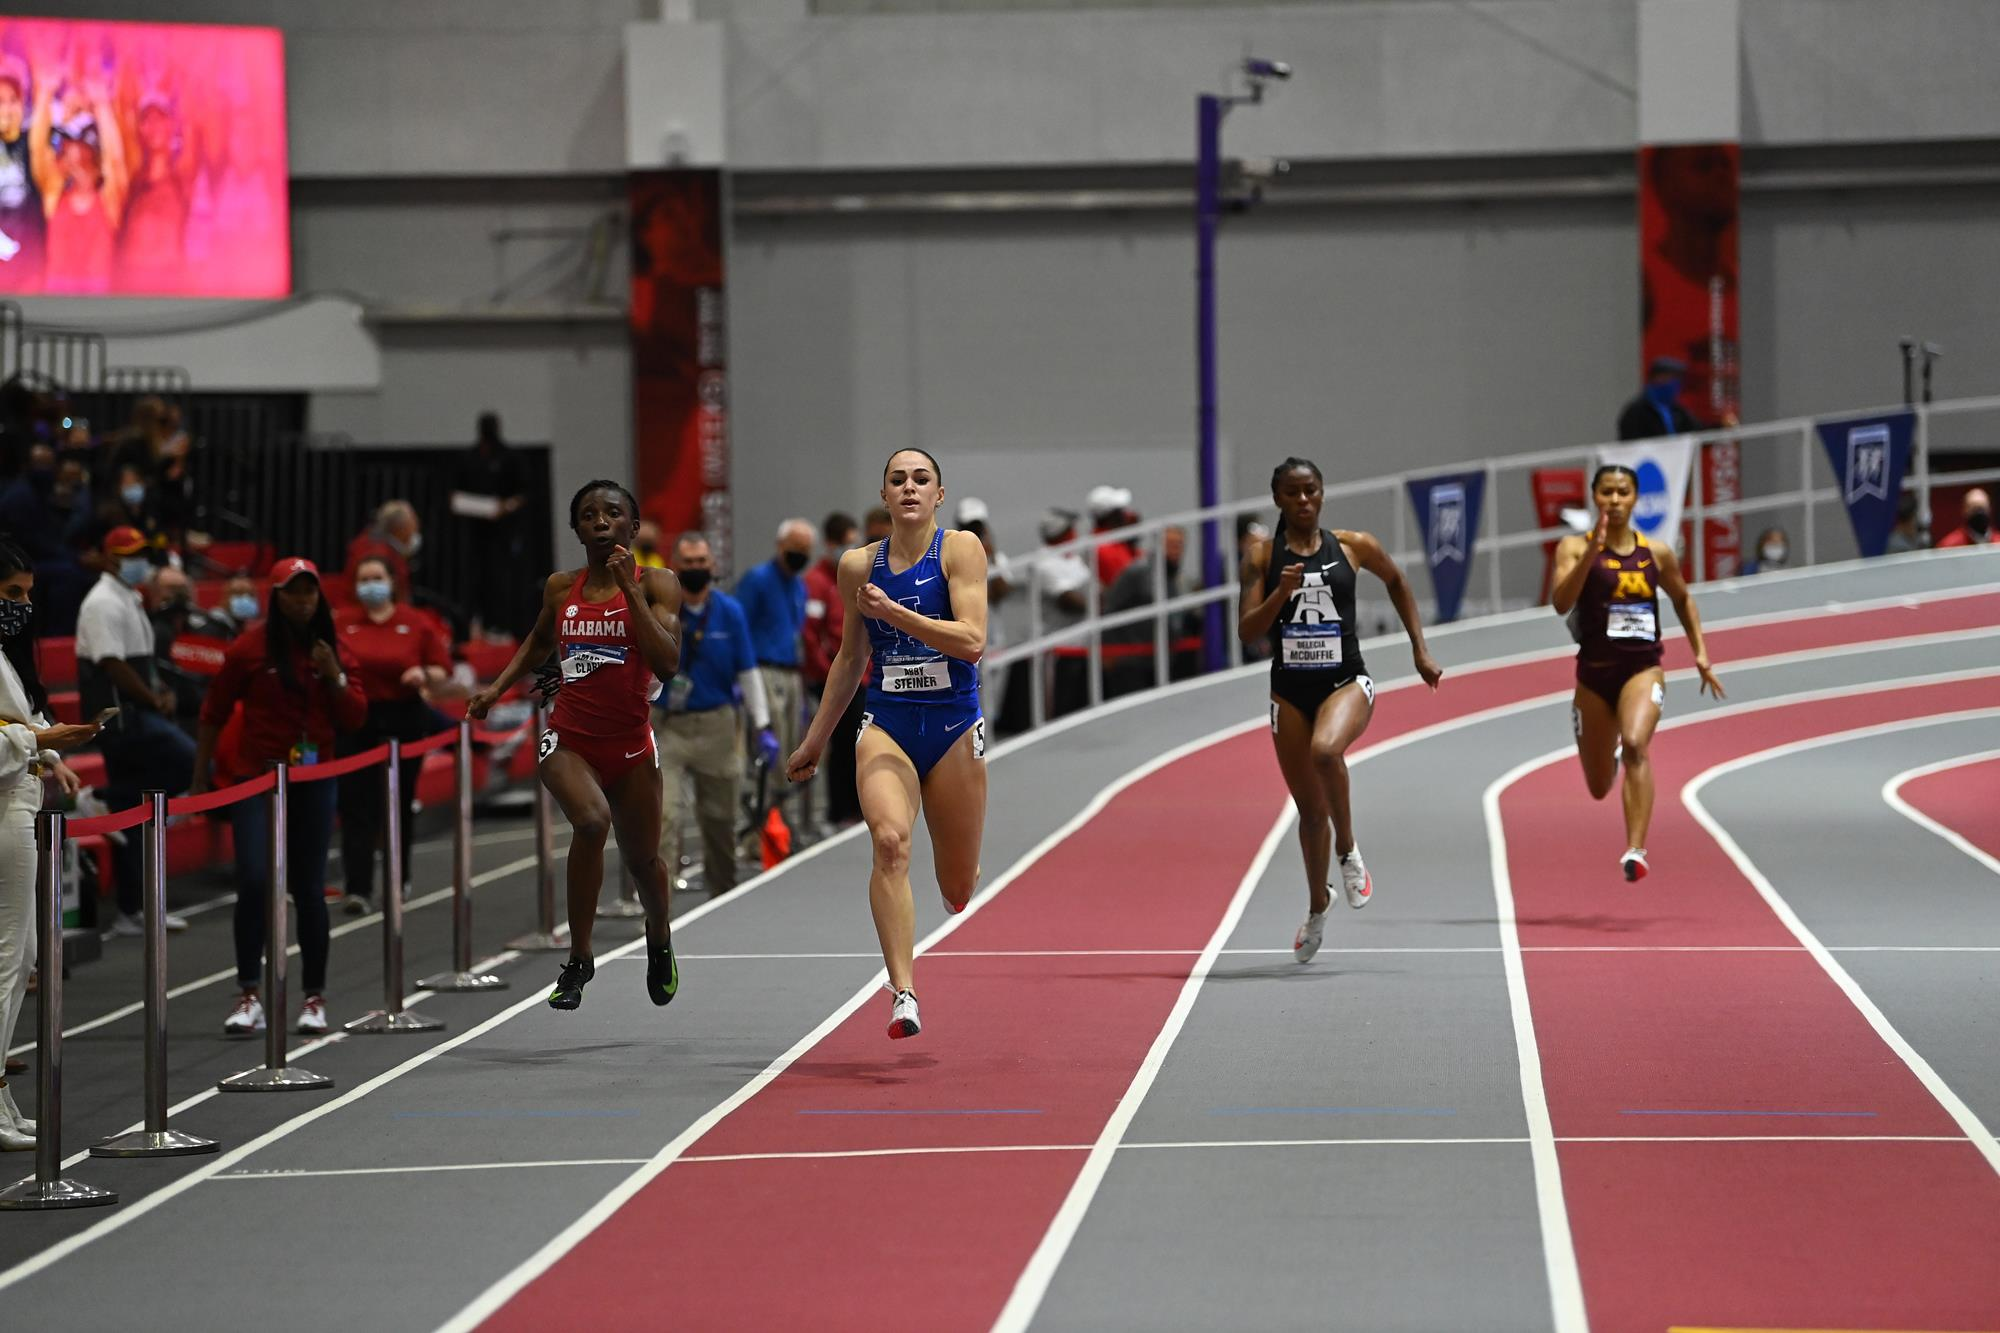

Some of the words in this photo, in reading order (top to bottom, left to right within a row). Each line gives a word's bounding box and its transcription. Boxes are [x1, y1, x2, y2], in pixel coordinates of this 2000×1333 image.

[1614, 571, 1653, 597] M
[561, 619, 627, 637] ALABAMA
[1297, 640, 1326, 649] DELECIA
[1290, 650, 1334, 660] MCDUFFIE
[904, 667, 924, 676] ABBY
[894, 676, 937, 690] STEINER
